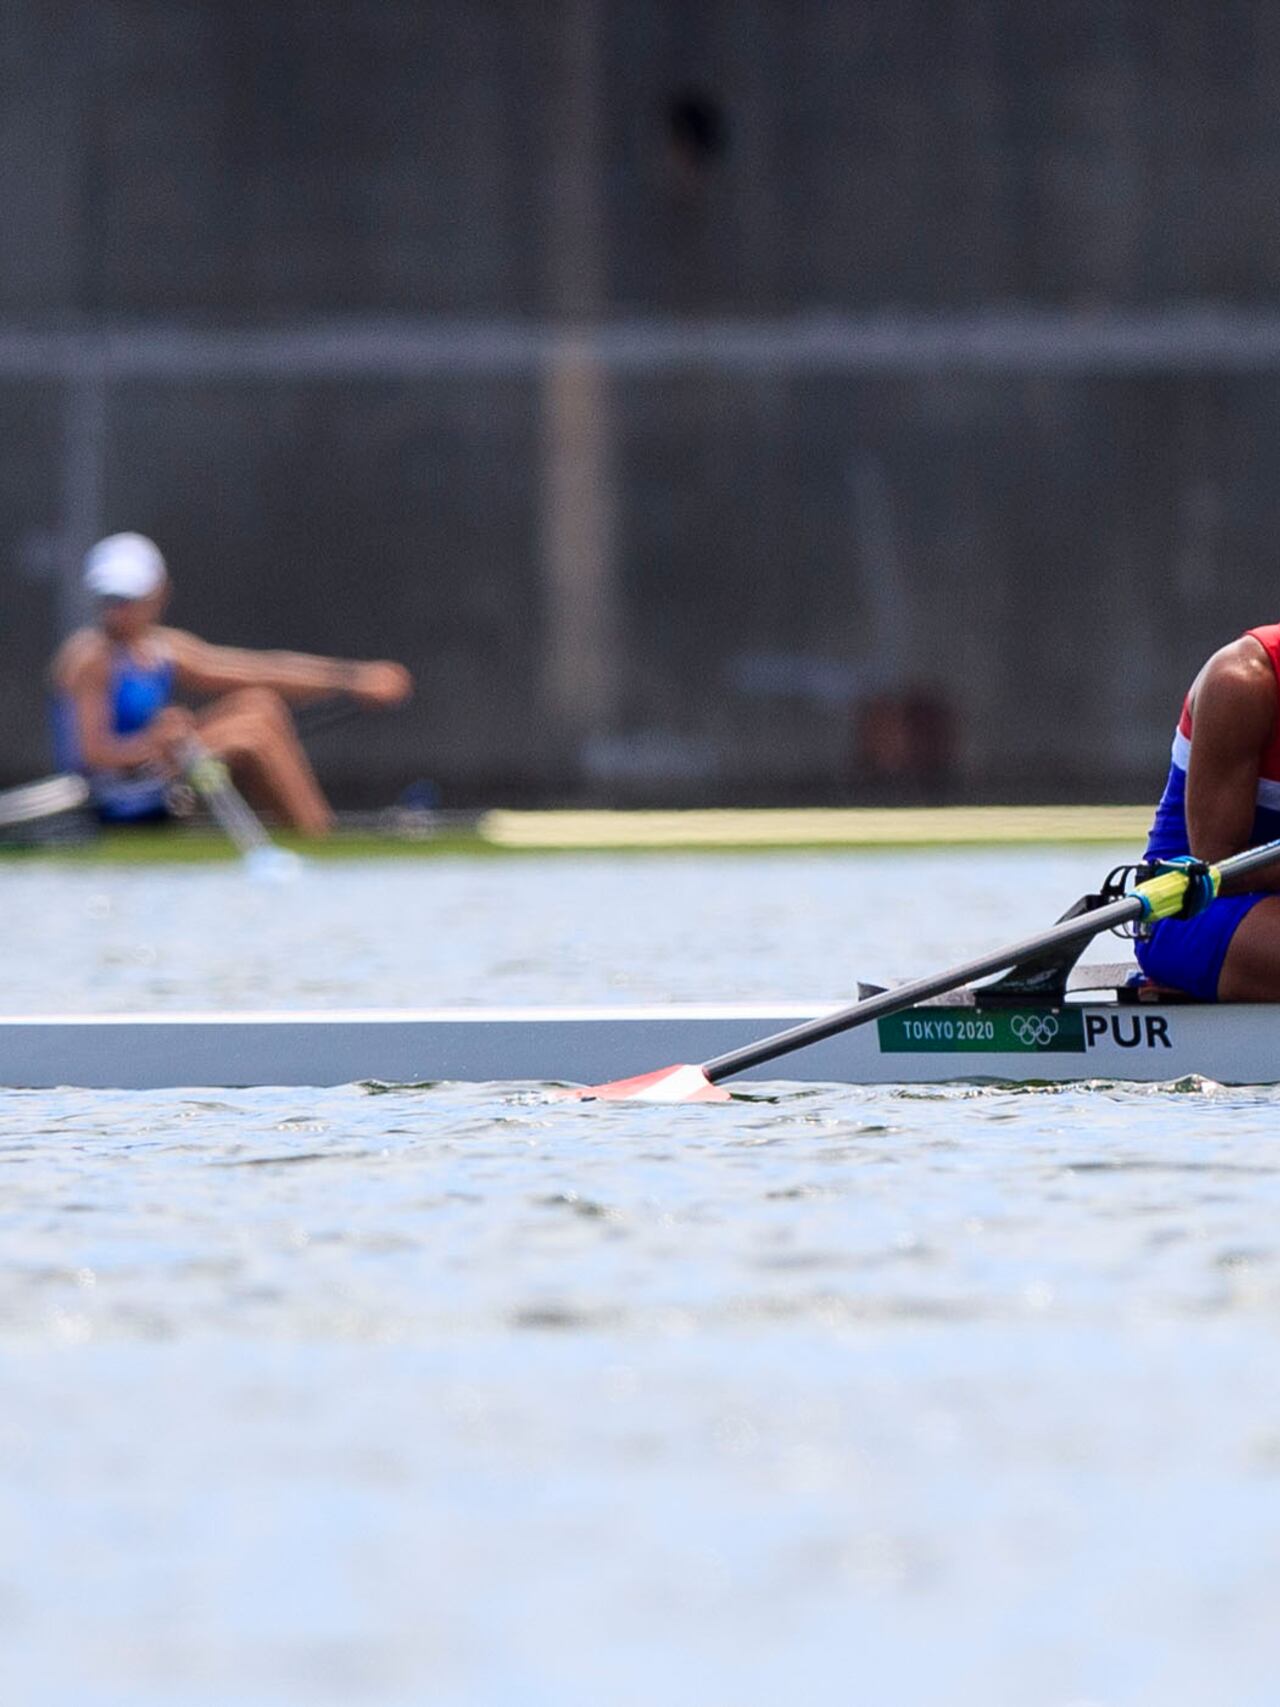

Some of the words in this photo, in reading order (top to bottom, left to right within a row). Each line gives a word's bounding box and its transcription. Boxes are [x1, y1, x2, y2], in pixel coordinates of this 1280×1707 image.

[903, 1021, 954, 1039] TOKYO
[956, 1021, 995, 1039] 2020
[1085, 1015, 1172, 1048] PUR
